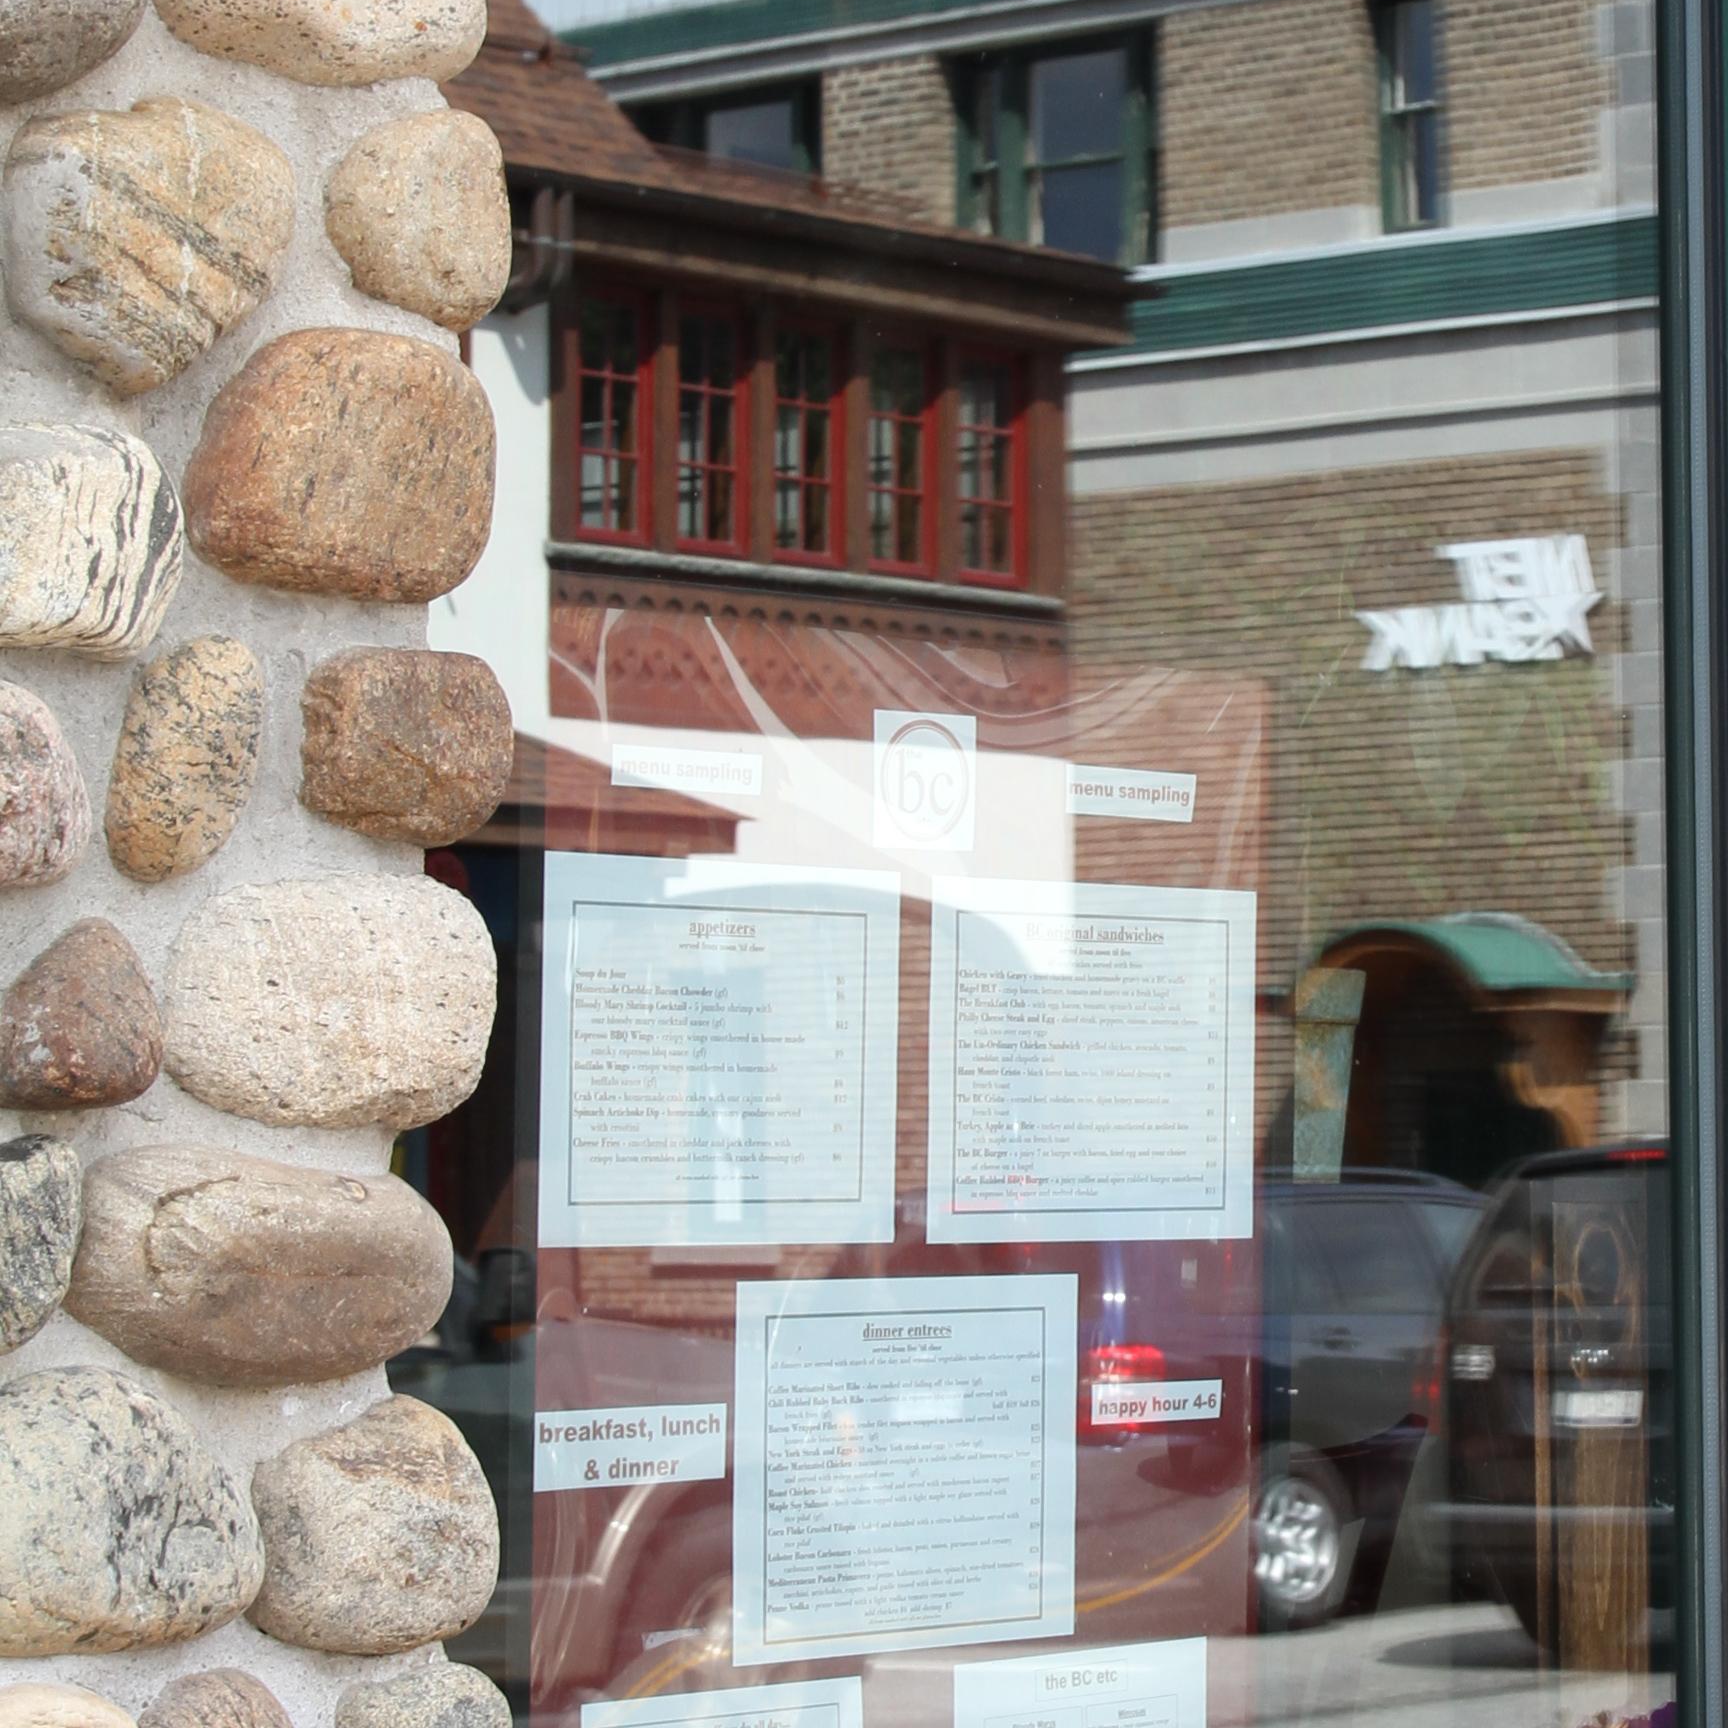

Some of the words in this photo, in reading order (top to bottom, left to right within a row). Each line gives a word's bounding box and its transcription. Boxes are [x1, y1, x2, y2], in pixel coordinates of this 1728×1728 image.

[621, 759, 670, 775] menu
[675, 762, 753, 785] sampling
[1071, 783, 1114, 797] menu
[1118, 785, 1190, 807] sampling
[689, 920, 756, 938] appetizers
[1097, 926, 1164, 942] sandwiches
[863, 1322, 903, 1341] dinner
[907, 1324, 952, 1339] entrees
[1098, 1400, 1147, 1417] happy
[1152, 1396, 1188, 1411] hour
[1193, 1393, 1217, 1409] 4-6
[540, 1419, 653, 1443] breakfast,
[662, 1414, 720, 1436] lunch
[584, 1459, 599, 1480] &
[608, 1458, 679, 1478] dinner
[1045, 1675, 1067, 1691] the
[1071, 1670, 1092, 1688] BC
[1096, 1669, 1118, 1684] etc
